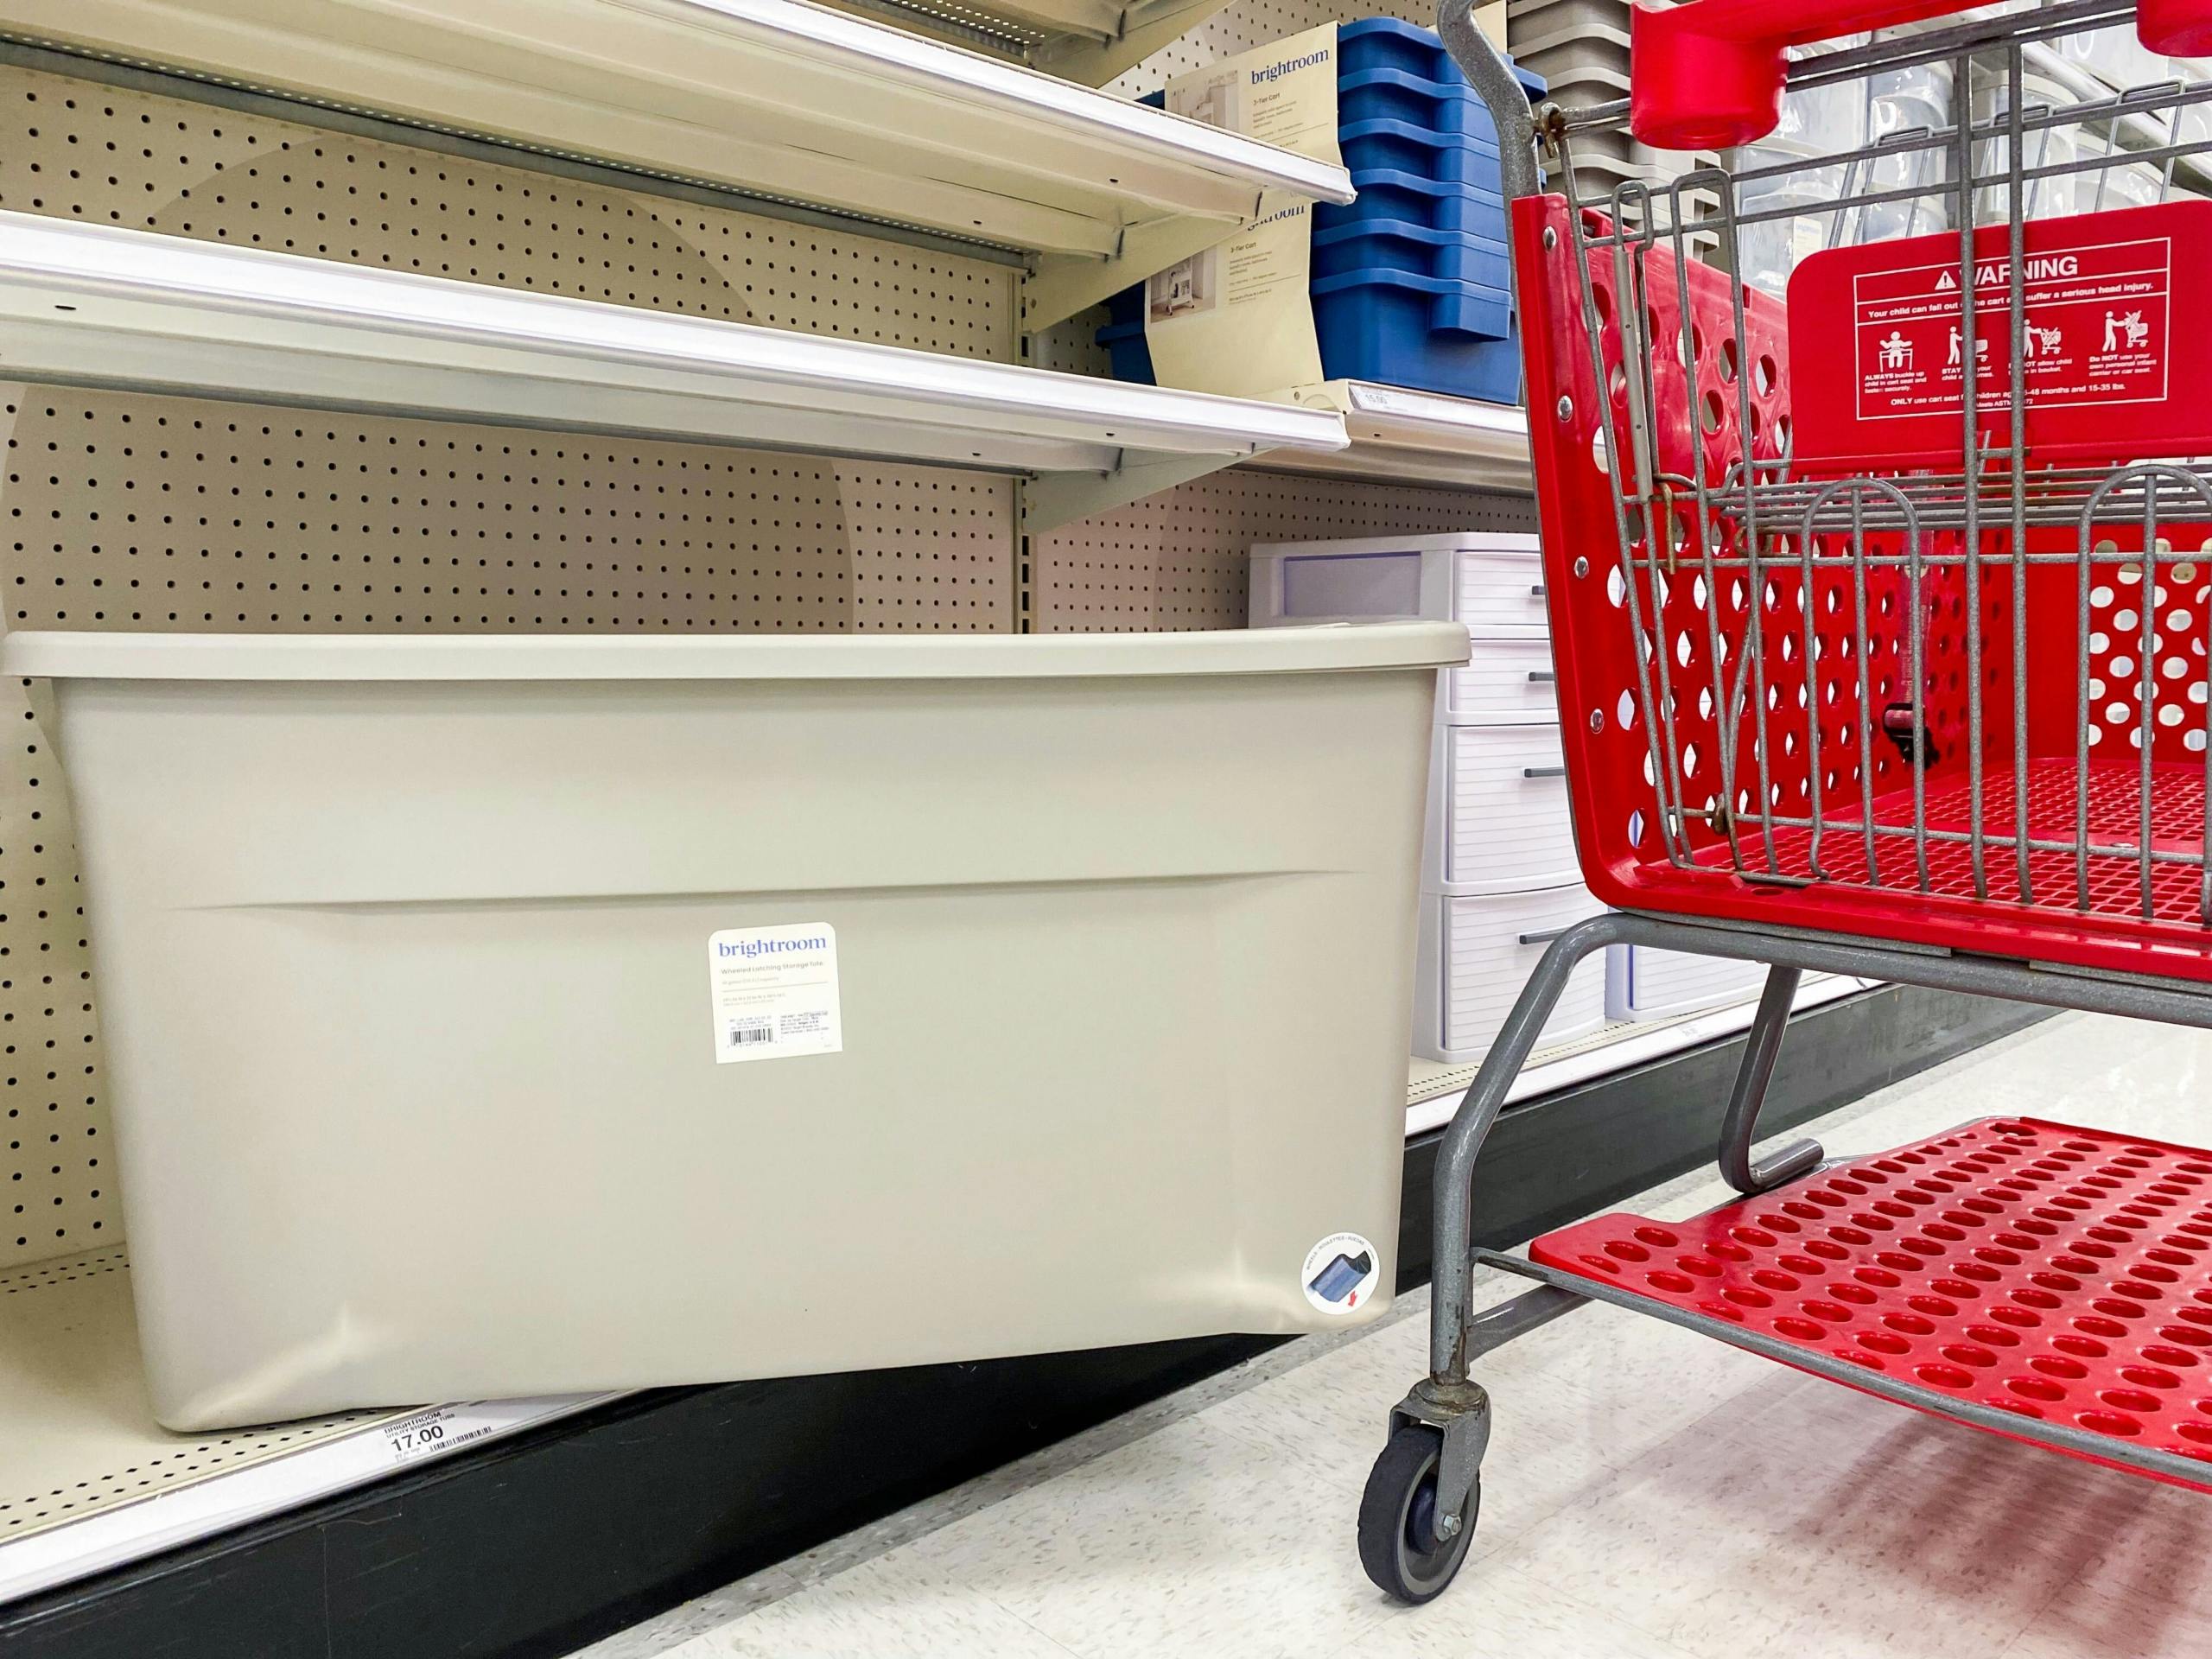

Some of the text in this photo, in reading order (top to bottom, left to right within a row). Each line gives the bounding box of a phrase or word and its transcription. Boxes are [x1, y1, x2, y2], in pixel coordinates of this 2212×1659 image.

[1251, 48, 1329, 85] brightroom
[1890, 308, 1910, 316] child
[2025, 292, 2052, 302] suffer
[2062, 288, 2095, 297] serious
[2098, 284, 2121, 294] head
[2124, 283, 2153, 293] injury.
[1865, 372, 1894, 381] ALWAYS
[2088, 384, 2111, 392] 15-35
[719, 937, 827, 959] brightroom
[721, 966, 752, 975] Wheeled
[752, 963, 782, 972] Latching
[782, 961, 810, 969] Storage
[410, 1419, 438, 1432] STORAGE
[391, 1426, 444, 1452] 17.00
